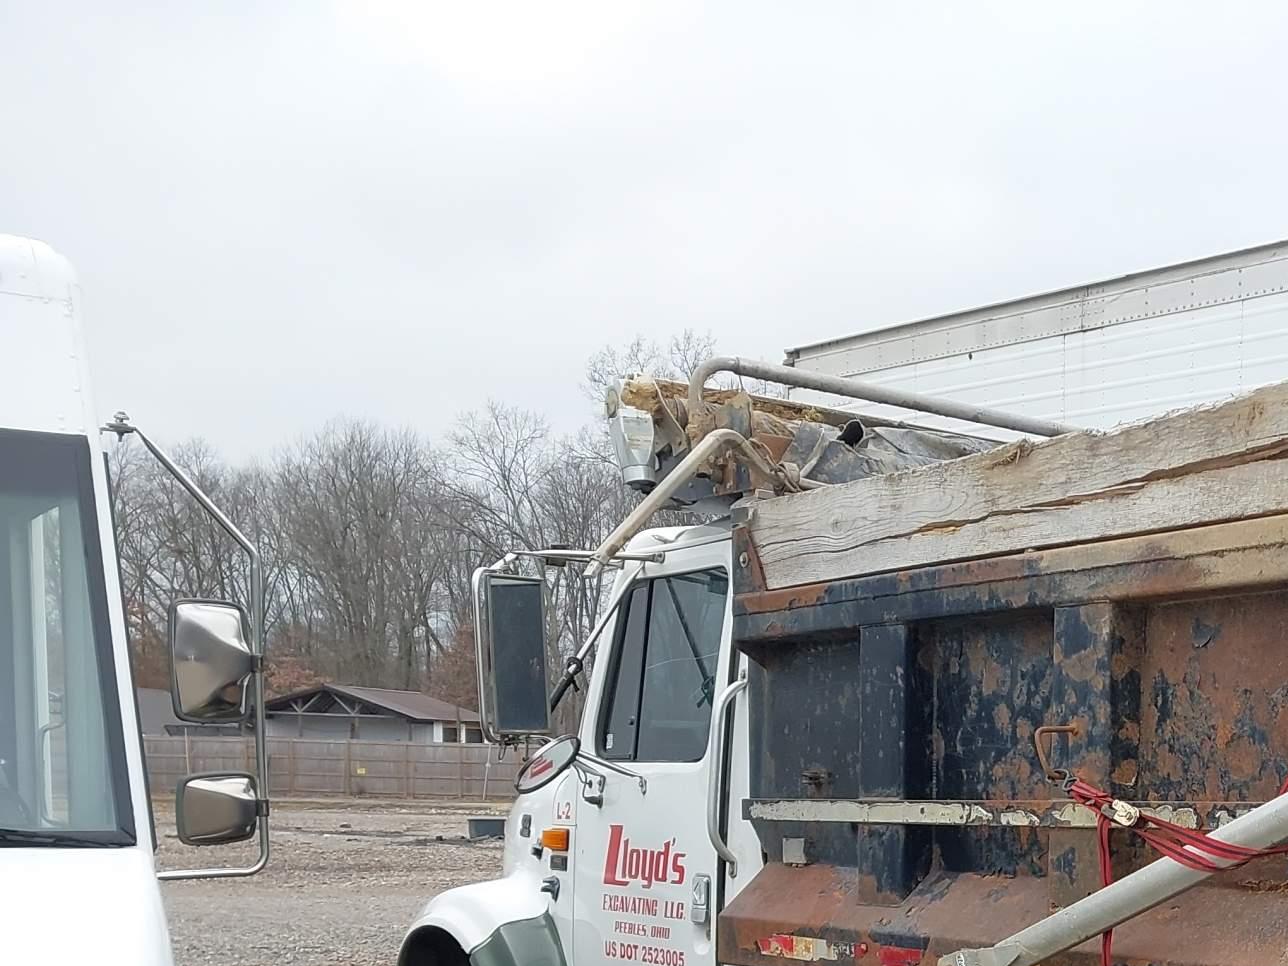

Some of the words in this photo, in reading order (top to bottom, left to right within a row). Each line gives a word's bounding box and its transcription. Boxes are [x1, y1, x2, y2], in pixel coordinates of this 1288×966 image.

[603, 824, 687, 889] Lloyd's
[602, 893, 658, 917] EXCAVATING
[664, 900, 686, 921] LLC.
[651, 925, 671, 940] OHIO
[605, 940, 617, 958] US
[620, 942, 639, 961] DOT
